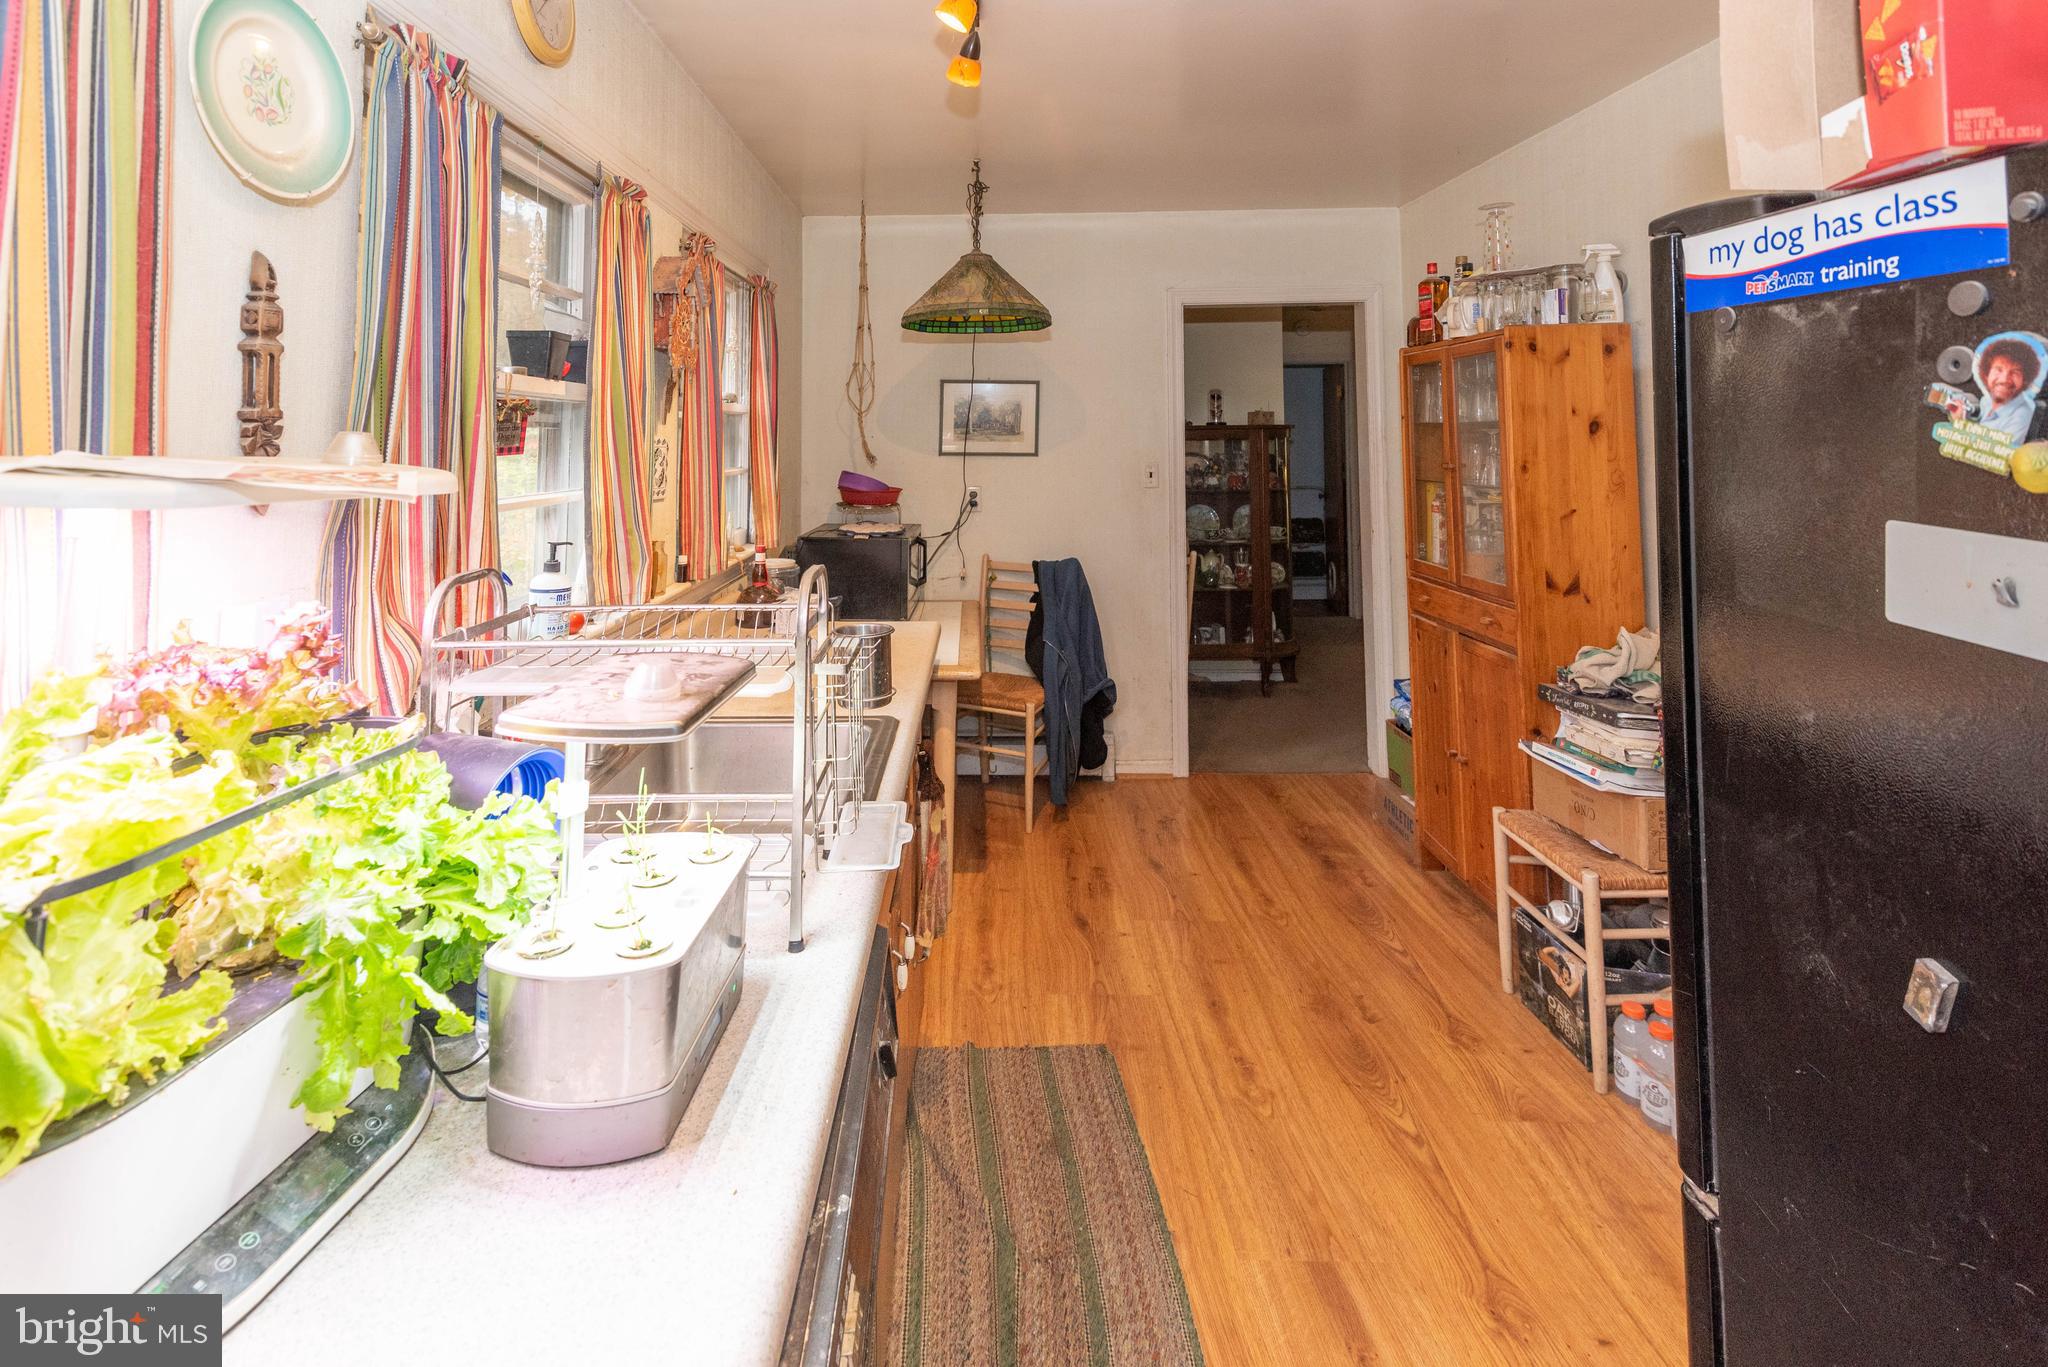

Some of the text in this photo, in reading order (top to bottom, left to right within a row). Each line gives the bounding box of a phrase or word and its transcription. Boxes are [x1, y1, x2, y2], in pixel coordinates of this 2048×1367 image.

[1709, 190, 1958, 268] my dog has class
[1745, 255, 1900, 295] PETSMART training
